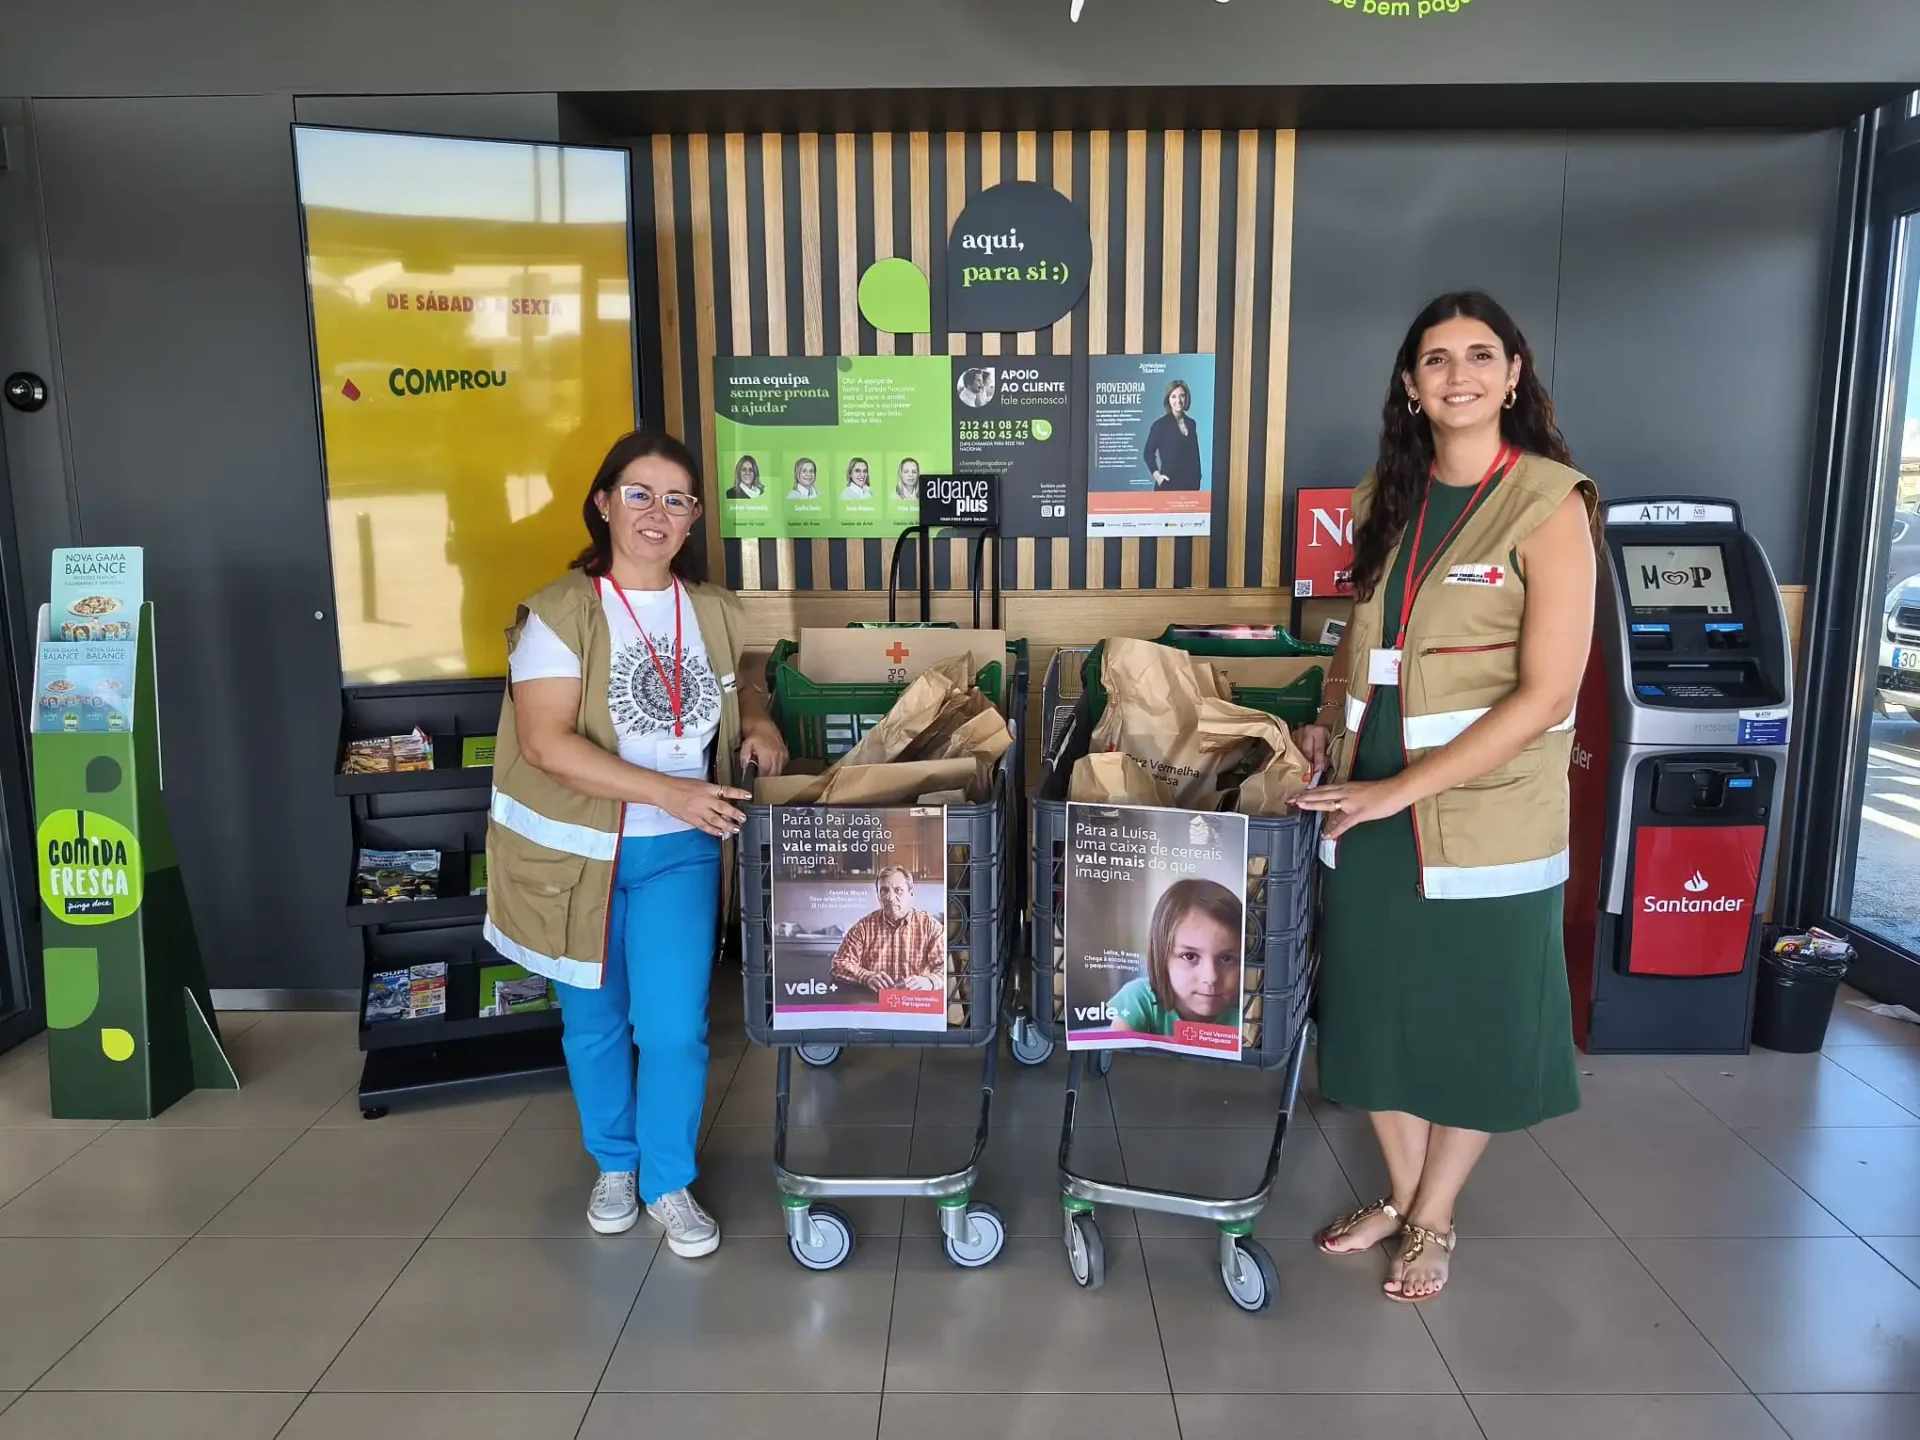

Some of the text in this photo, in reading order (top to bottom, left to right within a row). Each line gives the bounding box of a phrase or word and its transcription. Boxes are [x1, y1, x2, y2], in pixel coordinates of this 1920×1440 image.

[1363, 0, 1410, 15] bem
[1417, 0, 1475, 19] pag
[962, 228, 1024, 255] aqui,
[962, 266, 1021, 287] para
[1026, 260, 1047, 281] si
[387, 293, 410, 311] DE
[388, 367, 507, 397] COMPROU
[729, 373, 810, 389] uma equipa
[1001, 370, 1039, 380] APOIO
[730, 387, 830, 401] sempre pronta
[1001, 381, 1065, 392] AO CLIENTE
[1096, 382, 1146, 394] PROVEDORIA
[1001, 394, 1018, 405] fale
[1096, 394, 1141, 404] DO CLIENTE
[730, 401, 788, 417] a ajudar
[960, 421, 1028, 430] 212 41 08 74
[960, 431, 1028, 440] 808 20 45 45
[926, 477, 988, 505] algarve
[956, 495, 989, 517] plus
[1639, 505, 1680, 521] ATM
[66, 553, 126, 563] NOVA GAMA
[65, 562, 126, 575] BALANCE
[44, 653, 79, 661] BALANCE
[86, 652, 125, 660] BALANCE
[1150, 759, 1200, 778] Vermelha
[783, 813, 882, 829] Para o Pai João,
[783, 828, 892, 842] uma lata de grão
[1076, 822, 1160, 841] Para a Luísa,
[783, 841, 895, 856] vale mais do que
[1076, 840, 1223, 861] uma caixa de cereais
[783, 853, 840, 868] imagina.
[1075, 852, 1197, 875] vale mais do que
[50, 867, 129, 897] FRESCA
[1075, 865, 1135, 883] imagina.
[67, 899, 112, 913] pingo doce
[1643, 896, 1745, 913] Santander
[373, 969, 410, 979] POUPE
